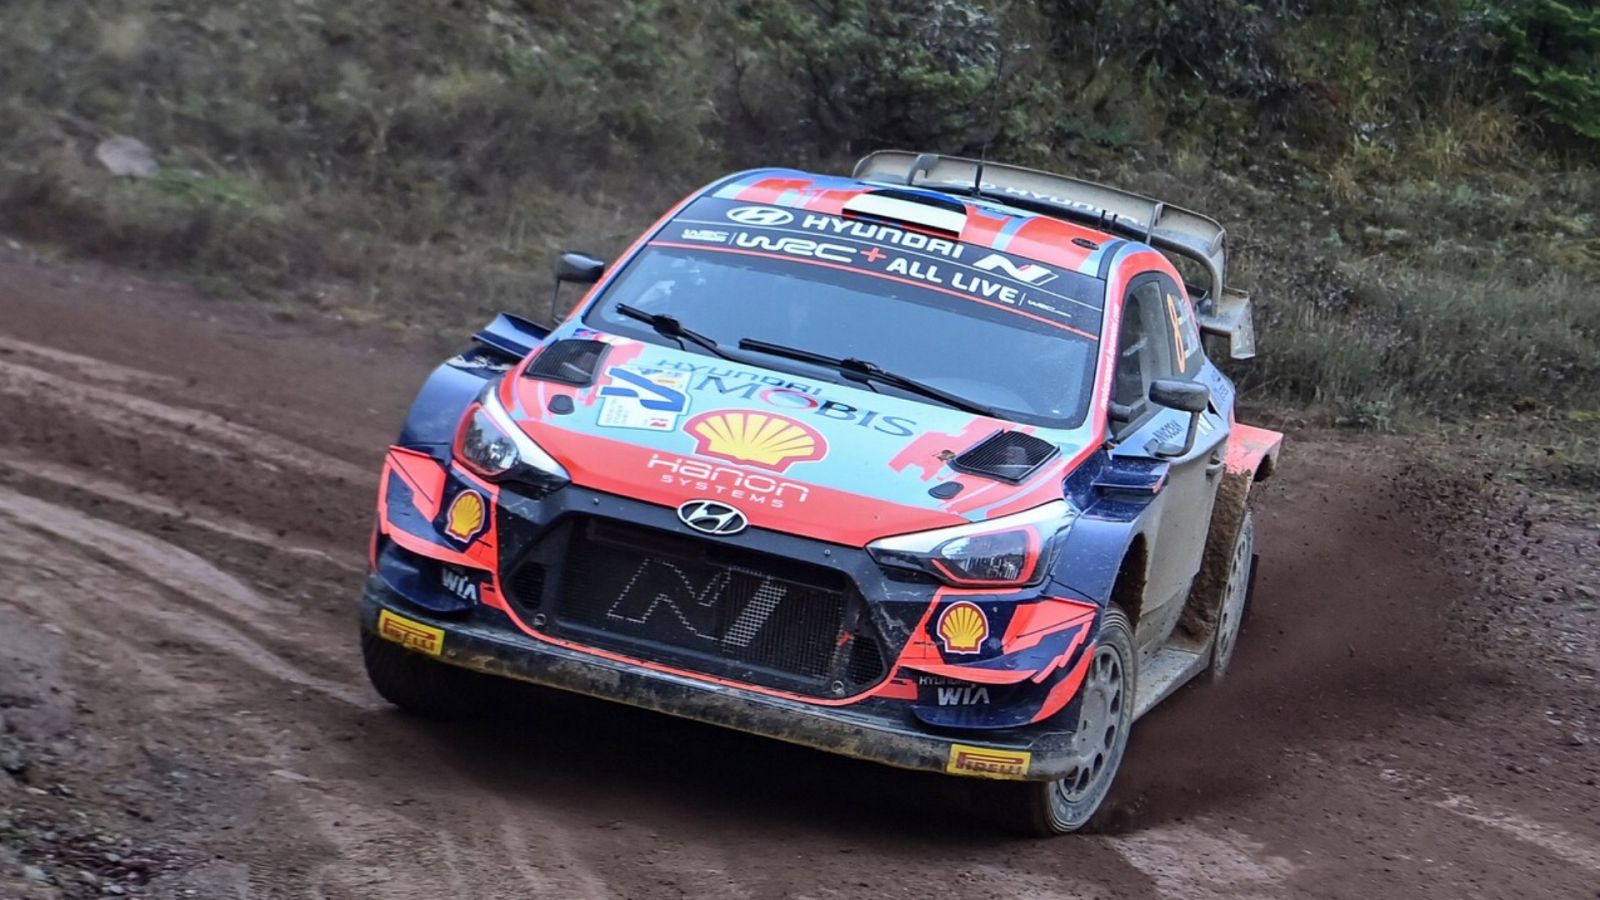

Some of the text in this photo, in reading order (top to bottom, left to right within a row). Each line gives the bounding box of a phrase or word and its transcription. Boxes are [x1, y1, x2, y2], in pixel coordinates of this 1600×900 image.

[802, 215, 1059, 286] HYUNDAI N
[886, 258, 942, 283] ALL
[951, 272, 1019, 304] LIVE
[657, 360, 822, 395] HYUNDAI
[693, 375, 917, 437] MOBIS
[660, 475, 784, 508] SYSTEMS
[443, 566, 478, 605] WIA
[937, 686, 990, 705] WIA
[956, 751, 1024, 775] PIRELLI
